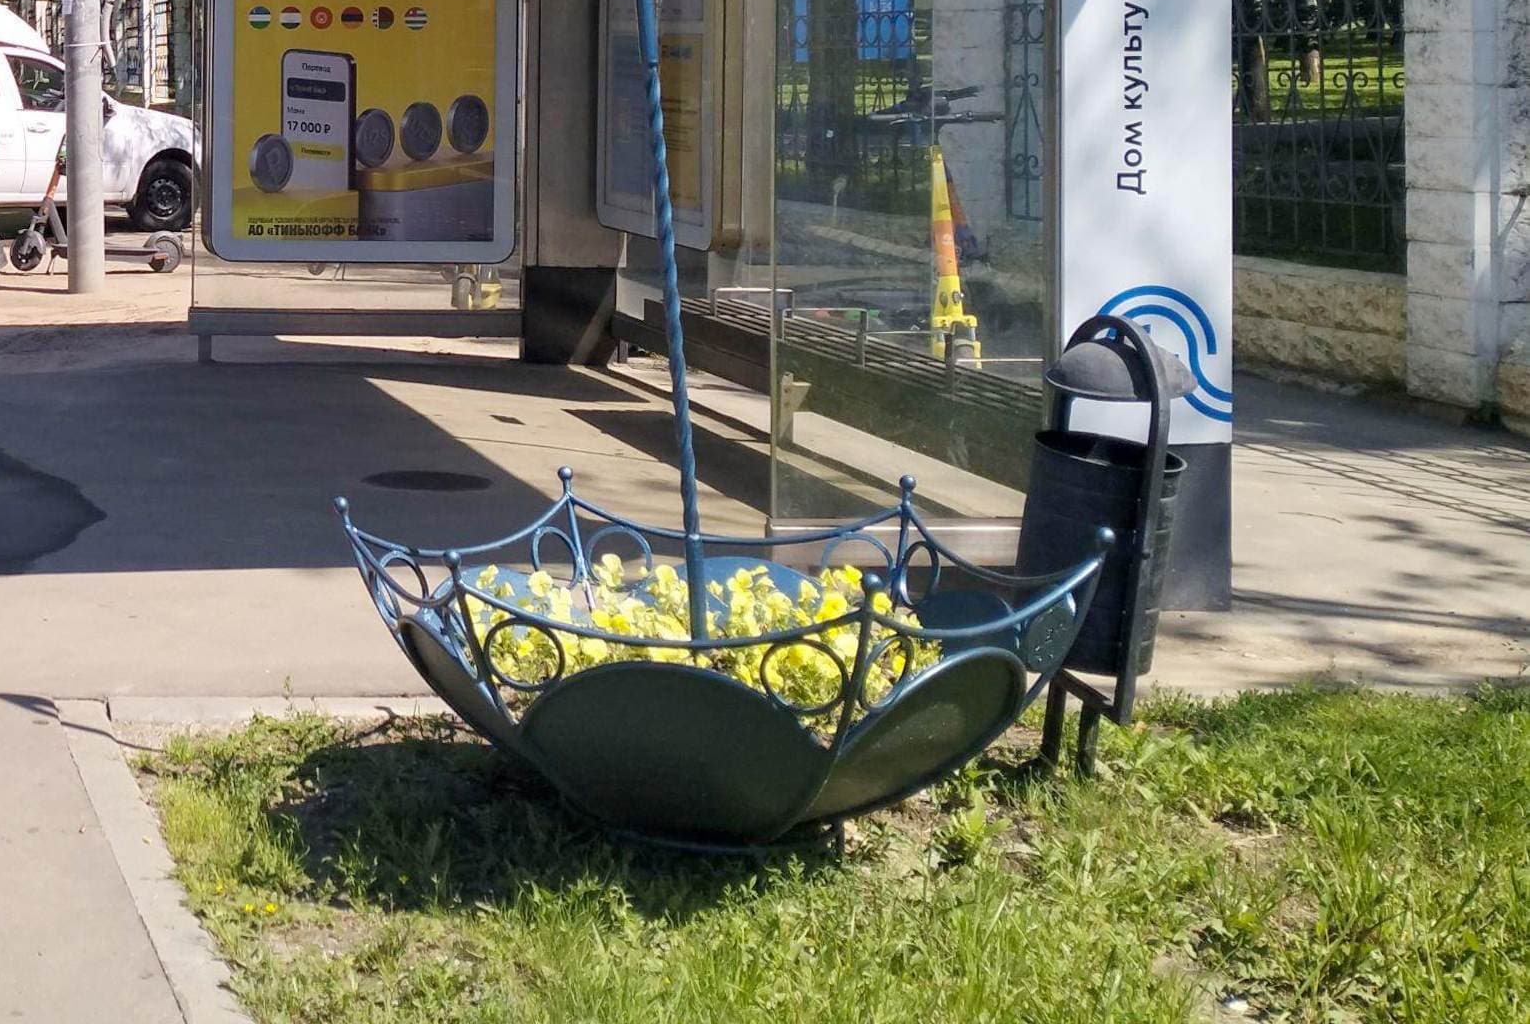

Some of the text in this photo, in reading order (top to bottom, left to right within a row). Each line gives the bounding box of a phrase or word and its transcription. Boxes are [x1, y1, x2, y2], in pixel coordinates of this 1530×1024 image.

[287, 120, 299, 131] 17
[300, 122, 322, 133] 000
[1117, 121, 1147, 195] Дом
[248, 224, 387, 236] АО «ТИНЬКОФФ БК»
